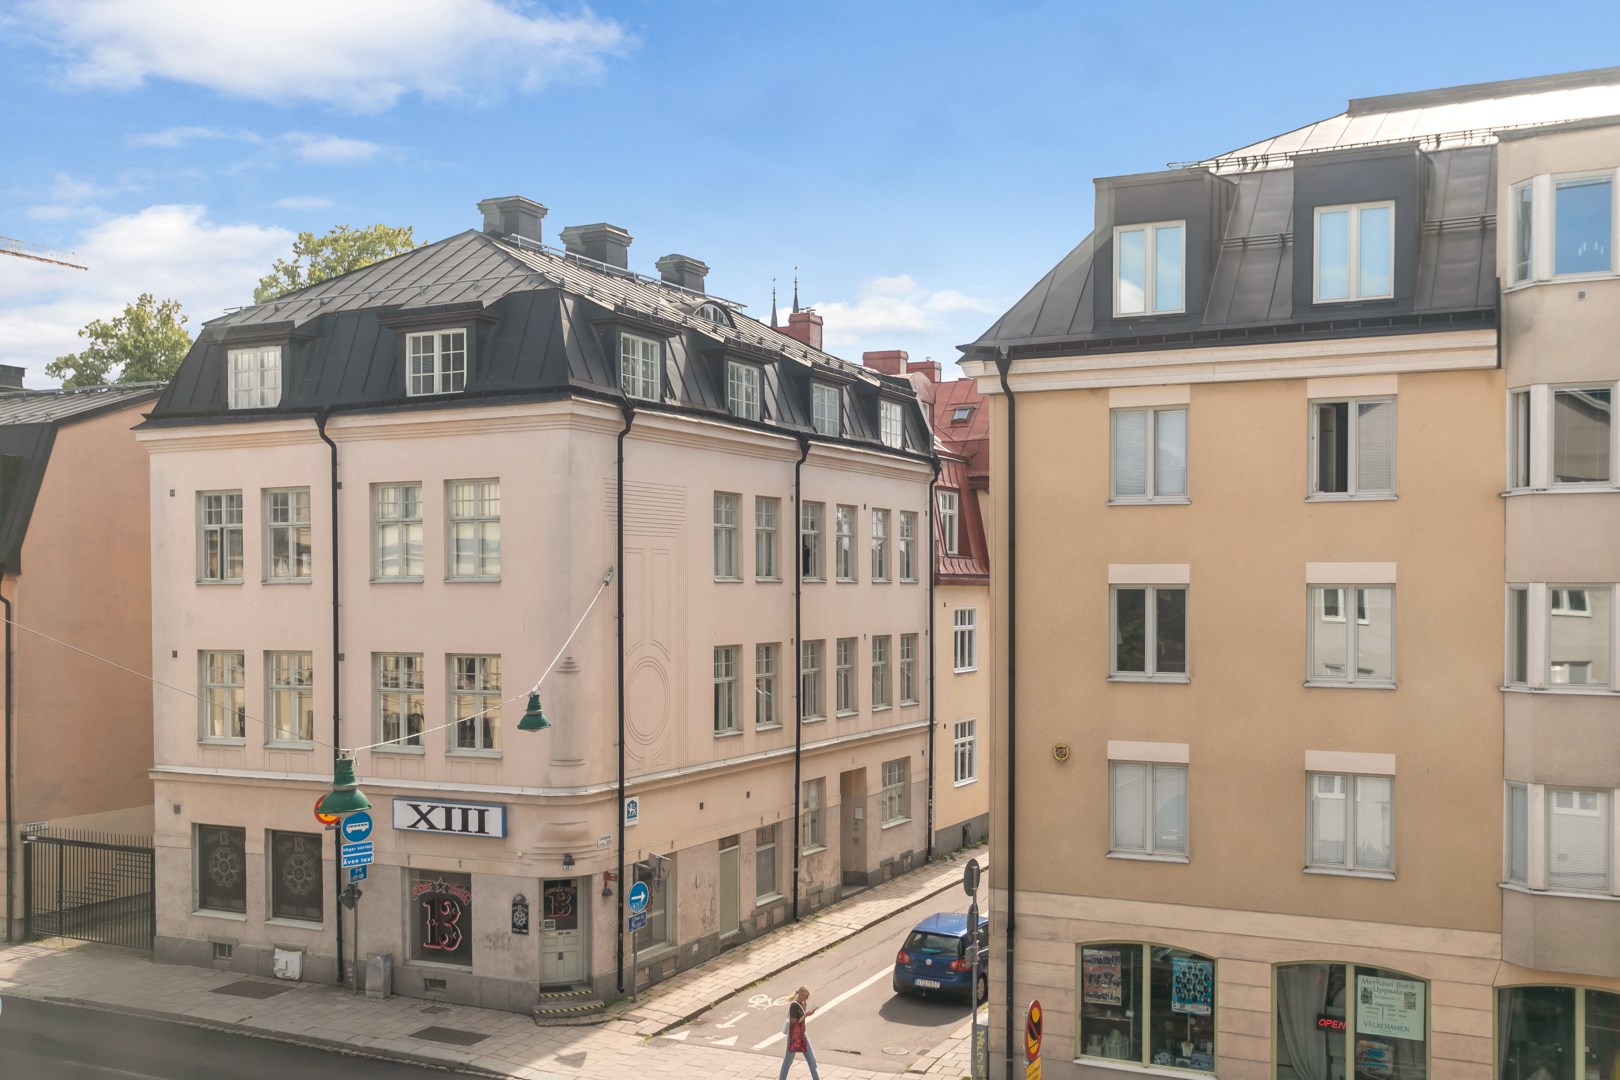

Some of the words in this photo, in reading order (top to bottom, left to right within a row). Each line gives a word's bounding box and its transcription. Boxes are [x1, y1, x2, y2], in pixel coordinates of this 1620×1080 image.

[406, 803, 490, 835] XIII
[548, 892, 572, 918] 13
[423, 900, 462, 951] 13
[1373, 985, 1403, 996] Uppsala
[1318, 1018, 1347, 1030] OPEN
[1363, 1020, 1410, 1033] VÄLKOMMEN
